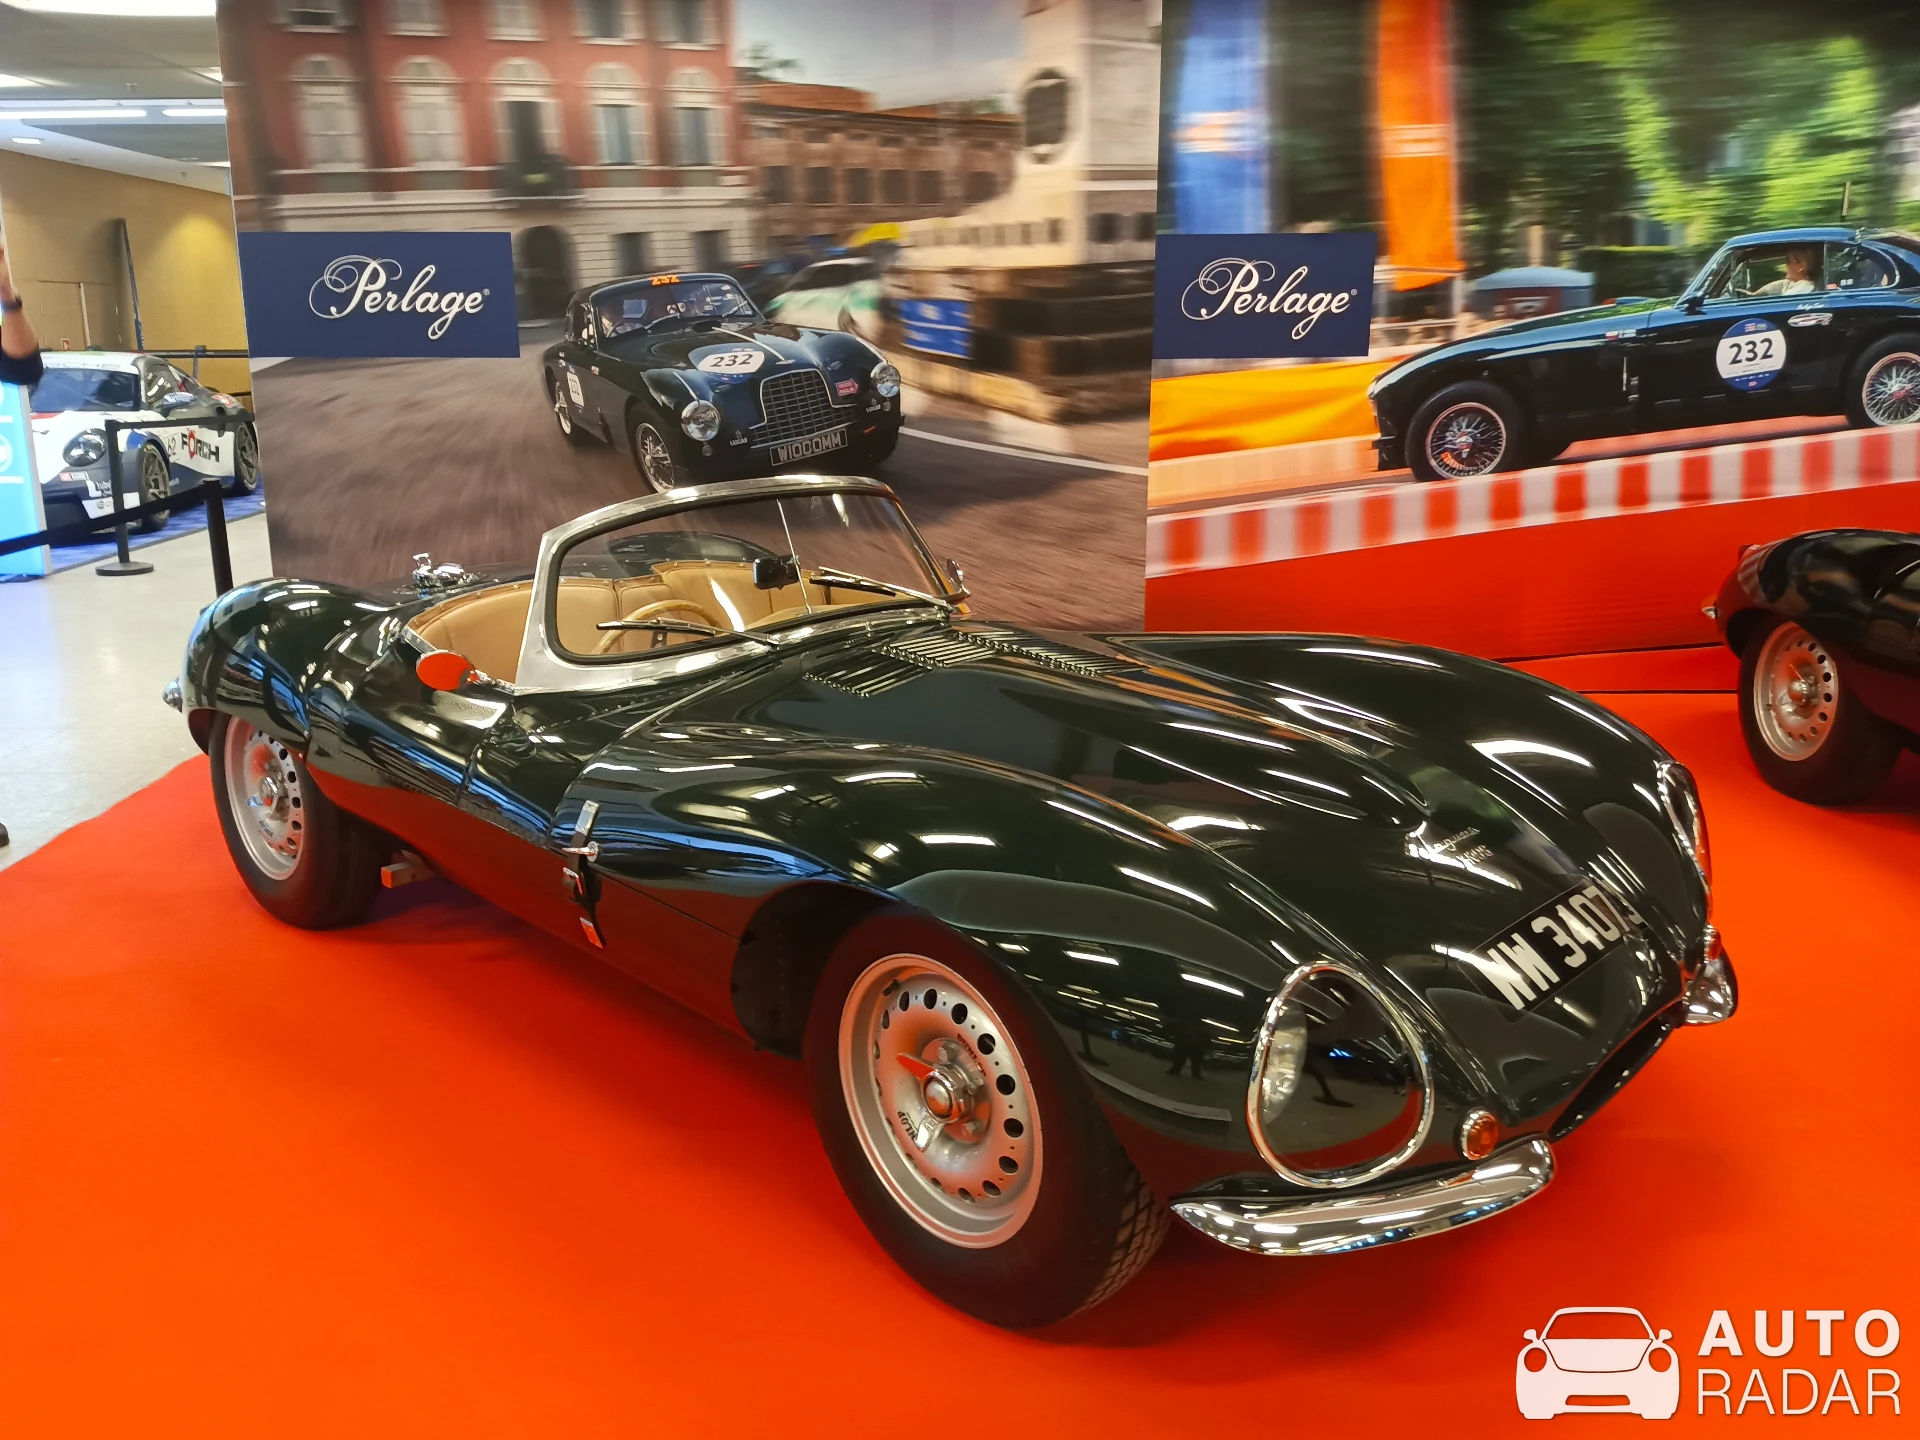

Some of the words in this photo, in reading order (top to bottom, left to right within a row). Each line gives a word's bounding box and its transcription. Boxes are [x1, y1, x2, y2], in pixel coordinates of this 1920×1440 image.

[309, 255, 484, 340] Perlage
[1181, 257, 1351, 340] Perlage
[709, 353, 753, 368] 232
[1728, 338, 1774, 365] 232
